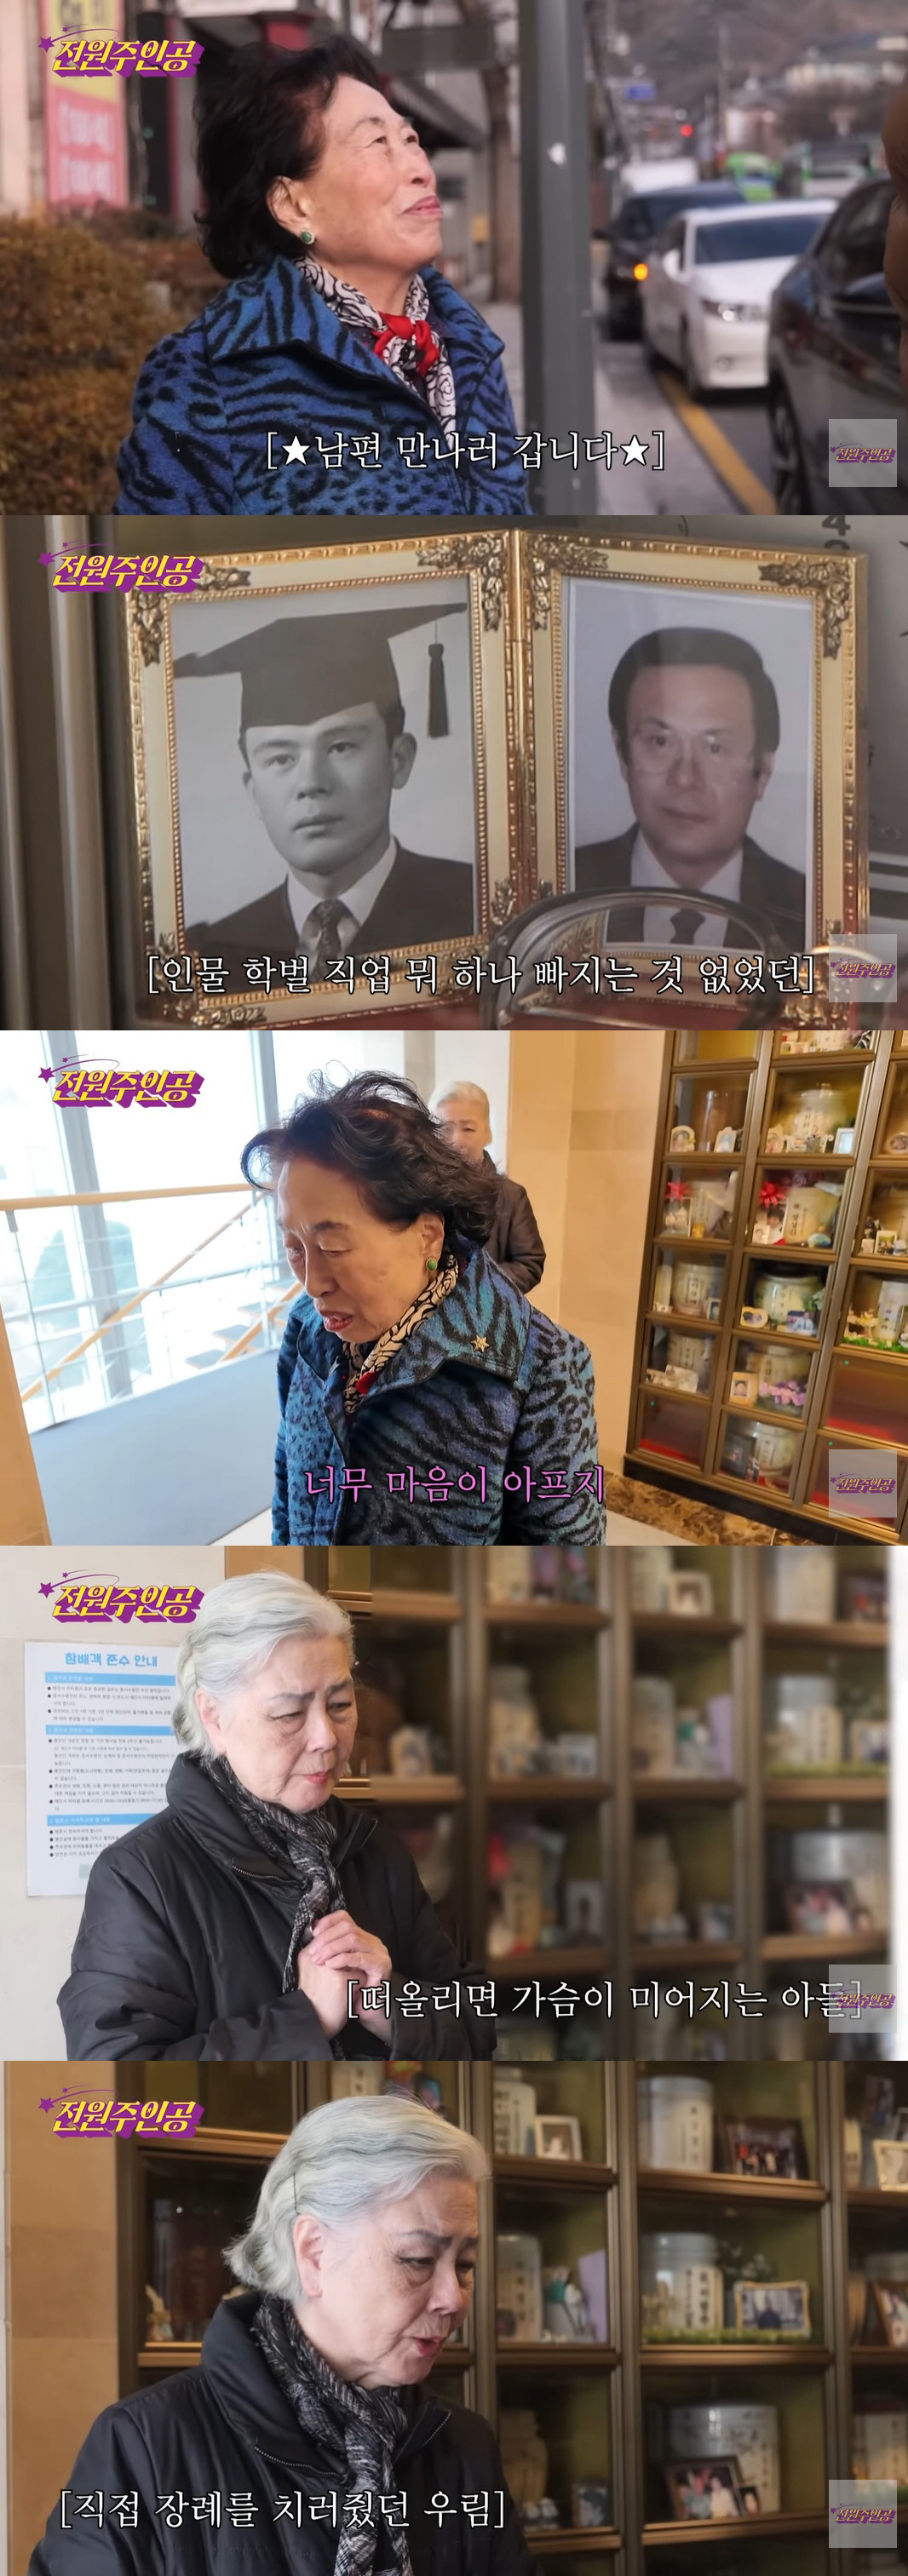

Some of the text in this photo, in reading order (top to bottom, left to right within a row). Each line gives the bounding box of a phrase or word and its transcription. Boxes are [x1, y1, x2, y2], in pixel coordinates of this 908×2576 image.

[65, 1651, 158, 1667] 참배객 준수 안내
